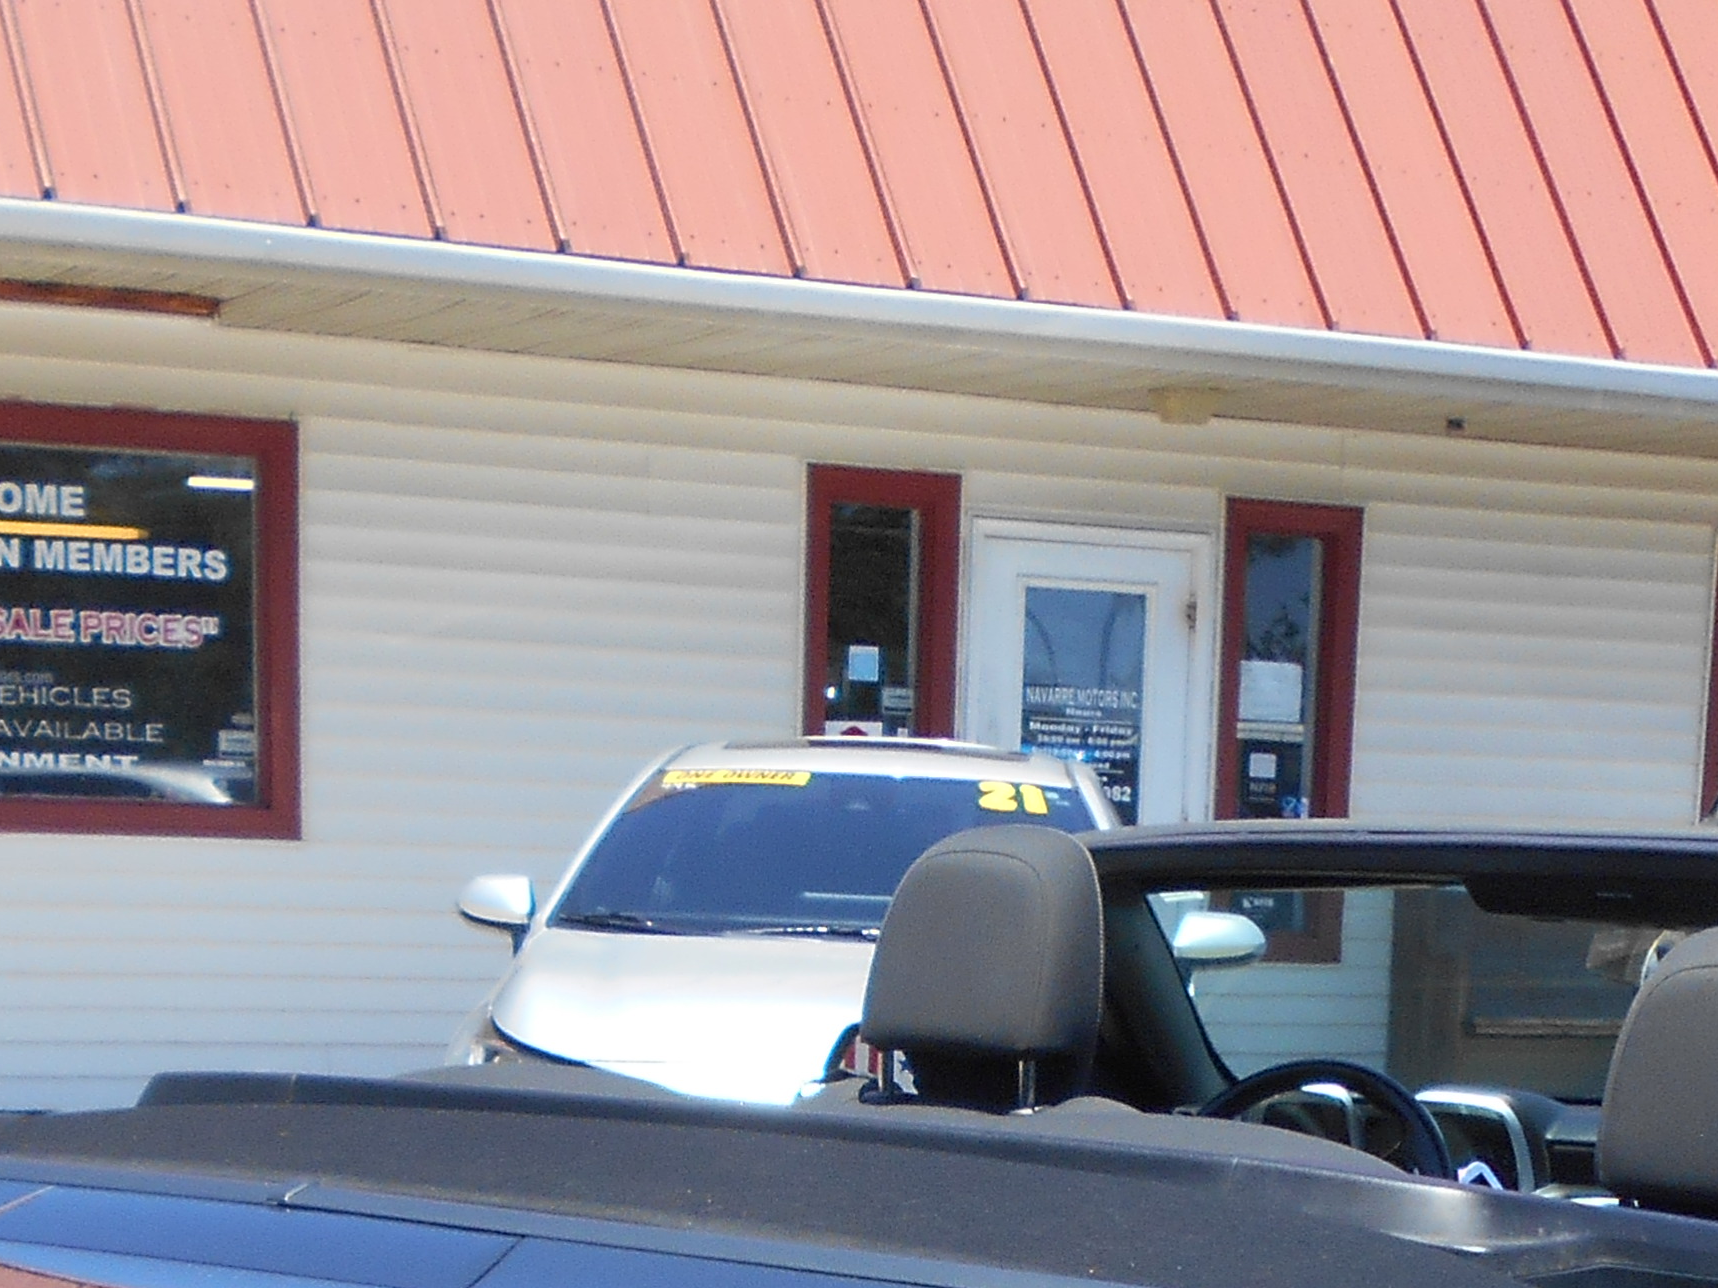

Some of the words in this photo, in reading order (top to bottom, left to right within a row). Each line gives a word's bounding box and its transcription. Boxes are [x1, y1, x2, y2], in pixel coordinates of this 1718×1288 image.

[33, 539, 229, 580] MEMBERS
[1077, 688, 1119, 708] MOTORS
[1029, 721, 1081, 734] Monday
[1091, 726, 1133, 736] Friday
[978, 781, 1049, 815] 21
